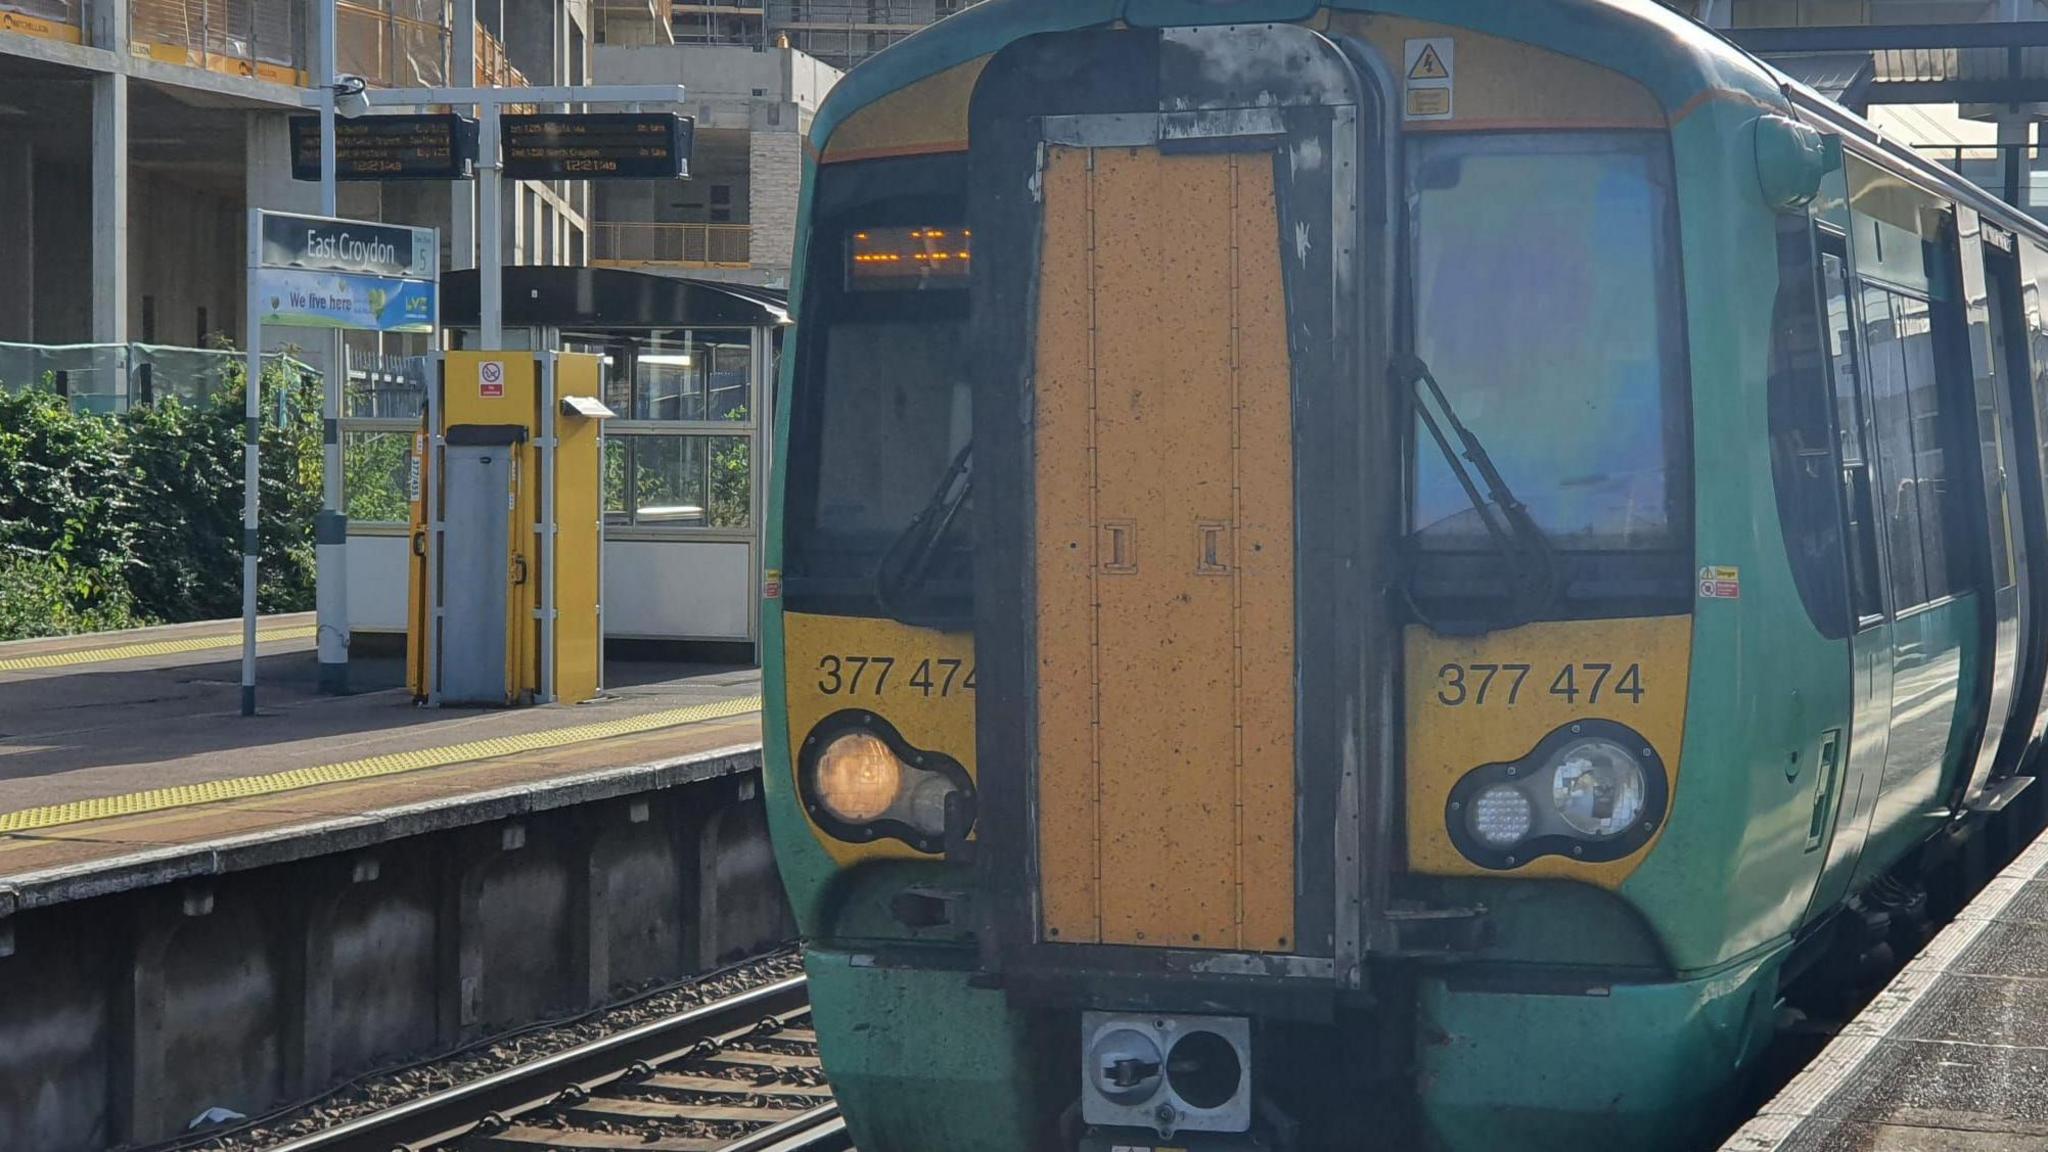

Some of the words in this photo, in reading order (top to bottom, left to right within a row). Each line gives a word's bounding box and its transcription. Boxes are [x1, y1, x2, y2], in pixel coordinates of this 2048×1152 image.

[307, 229, 336, 259] East
[339, 232, 395, 269] Croydon
[419, 248, 426, 271] 5
[290, 292, 306, 308] We
[309, 293, 327, 310] live
[330, 295, 352, 311] here
[818, 655, 894, 695] 377
[1437, 662, 1531, 706] 377
[1549, 662, 1645, 705] 474
